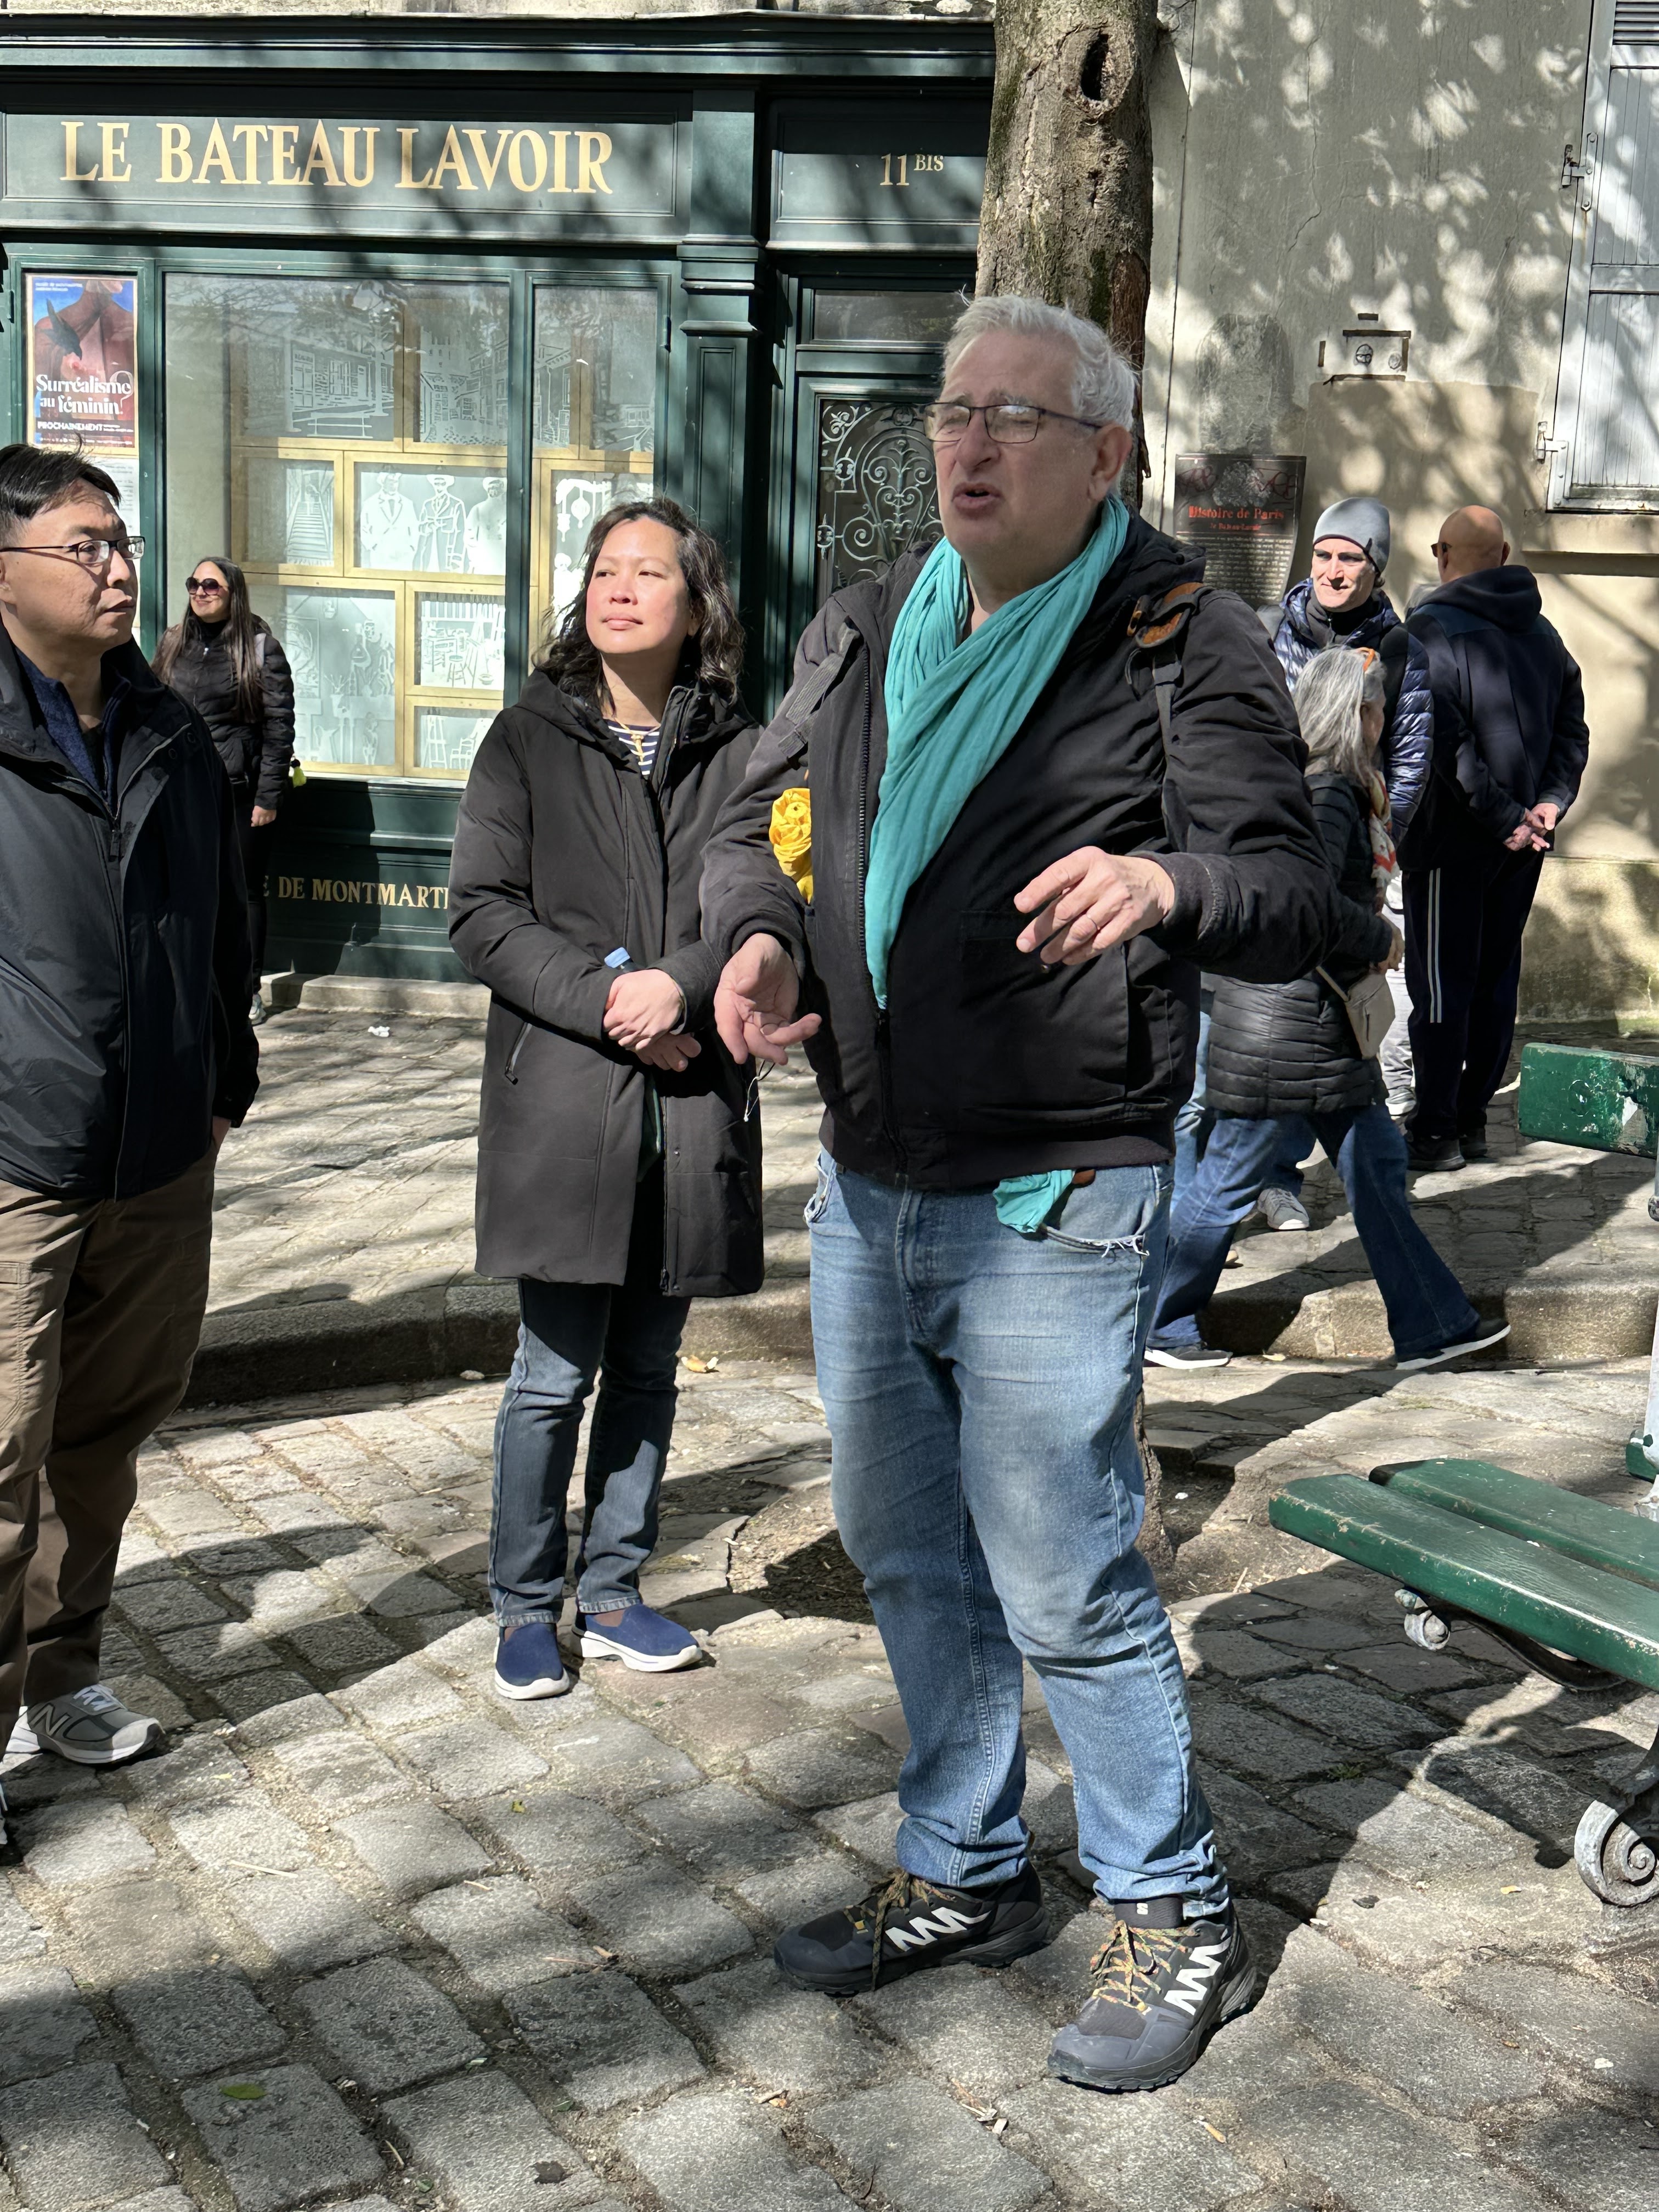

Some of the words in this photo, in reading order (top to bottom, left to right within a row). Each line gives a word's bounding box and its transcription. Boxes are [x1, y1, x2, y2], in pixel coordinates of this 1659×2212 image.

[60, 121, 132, 183] LE
[155, 118, 381, 187] BATEAU
[395, 124, 613, 194] LAVOIR
[36, 374, 132, 394] Surréalisme
[40, 398, 55, 407] au
[37, 421, 103, 431] PROCHAINEMENT
[1189, 506, 1233, 518] Histoire
[1237, 507, 1249, 519] de
[1254, 507, 1284, 520] Paris
[278, 876, 305, 899] DE
